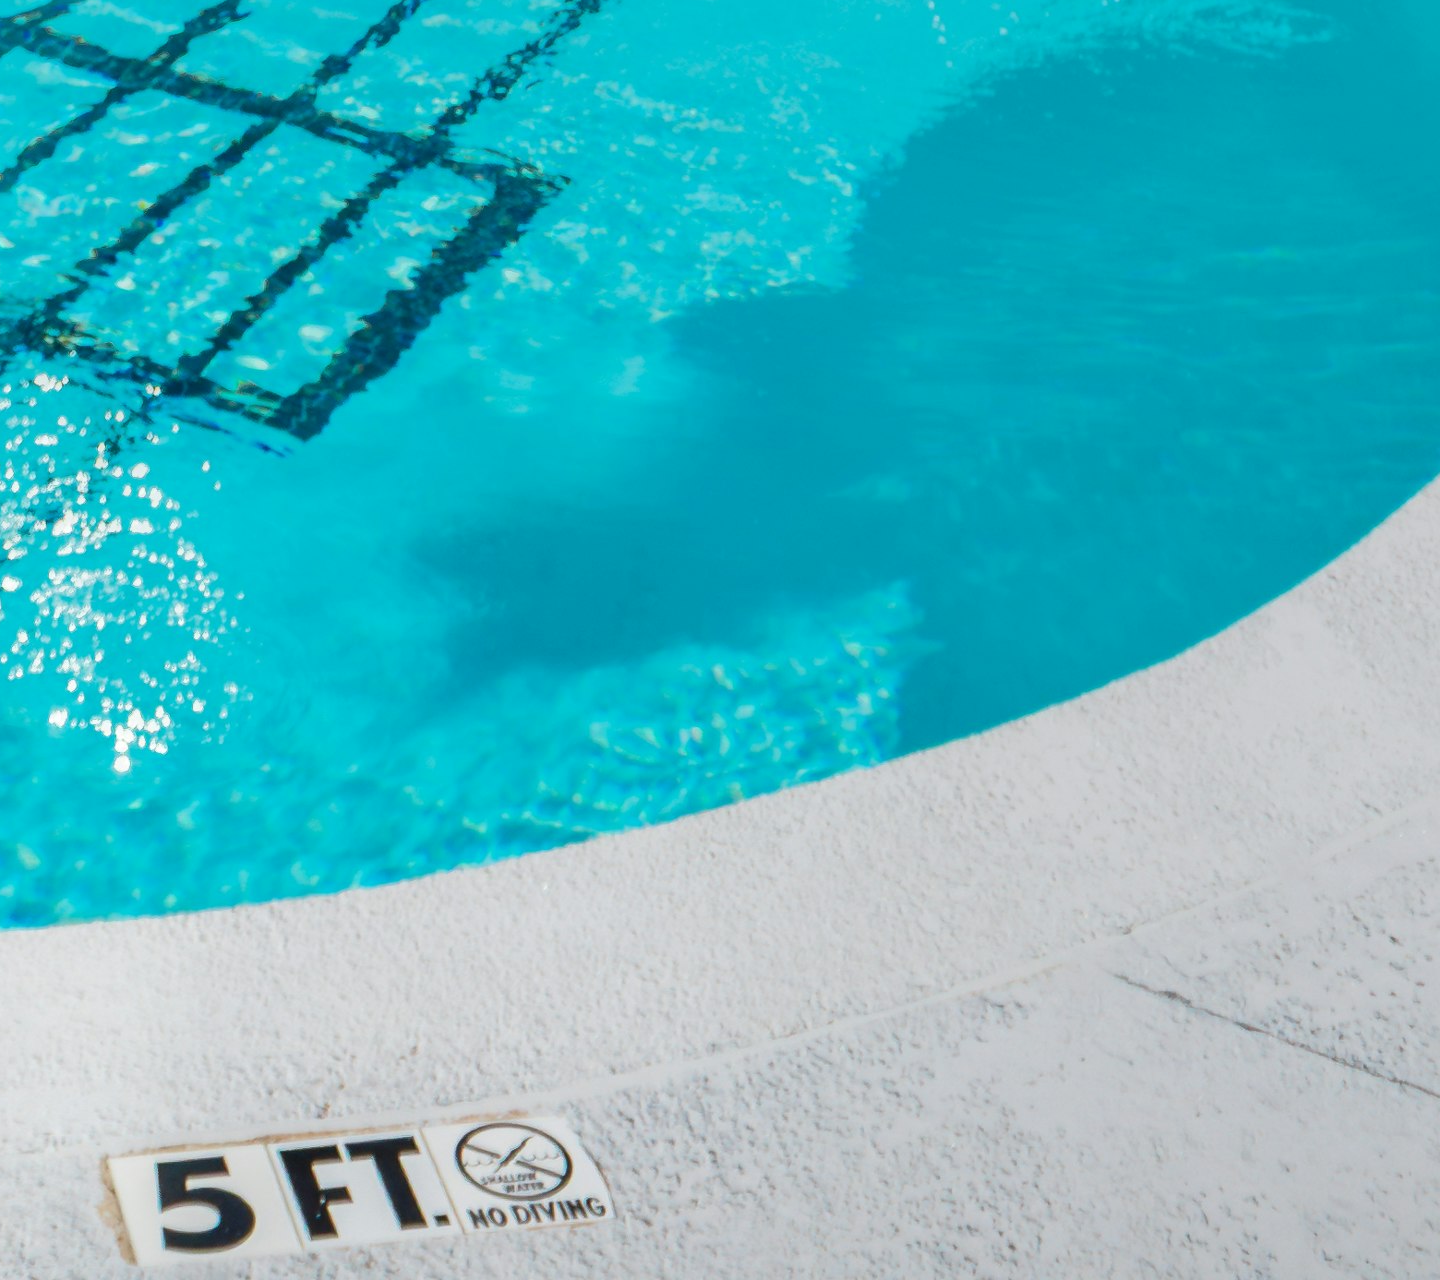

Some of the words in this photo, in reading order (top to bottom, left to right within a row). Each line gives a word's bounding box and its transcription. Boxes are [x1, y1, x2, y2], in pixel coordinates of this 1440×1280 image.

[155, 1156, 257, 1254] 5
[278, 1135, 451, 1241] FT.
[467, 1206, 509, 1230] NO
[510, 1196, 607, 1226] DIVING
